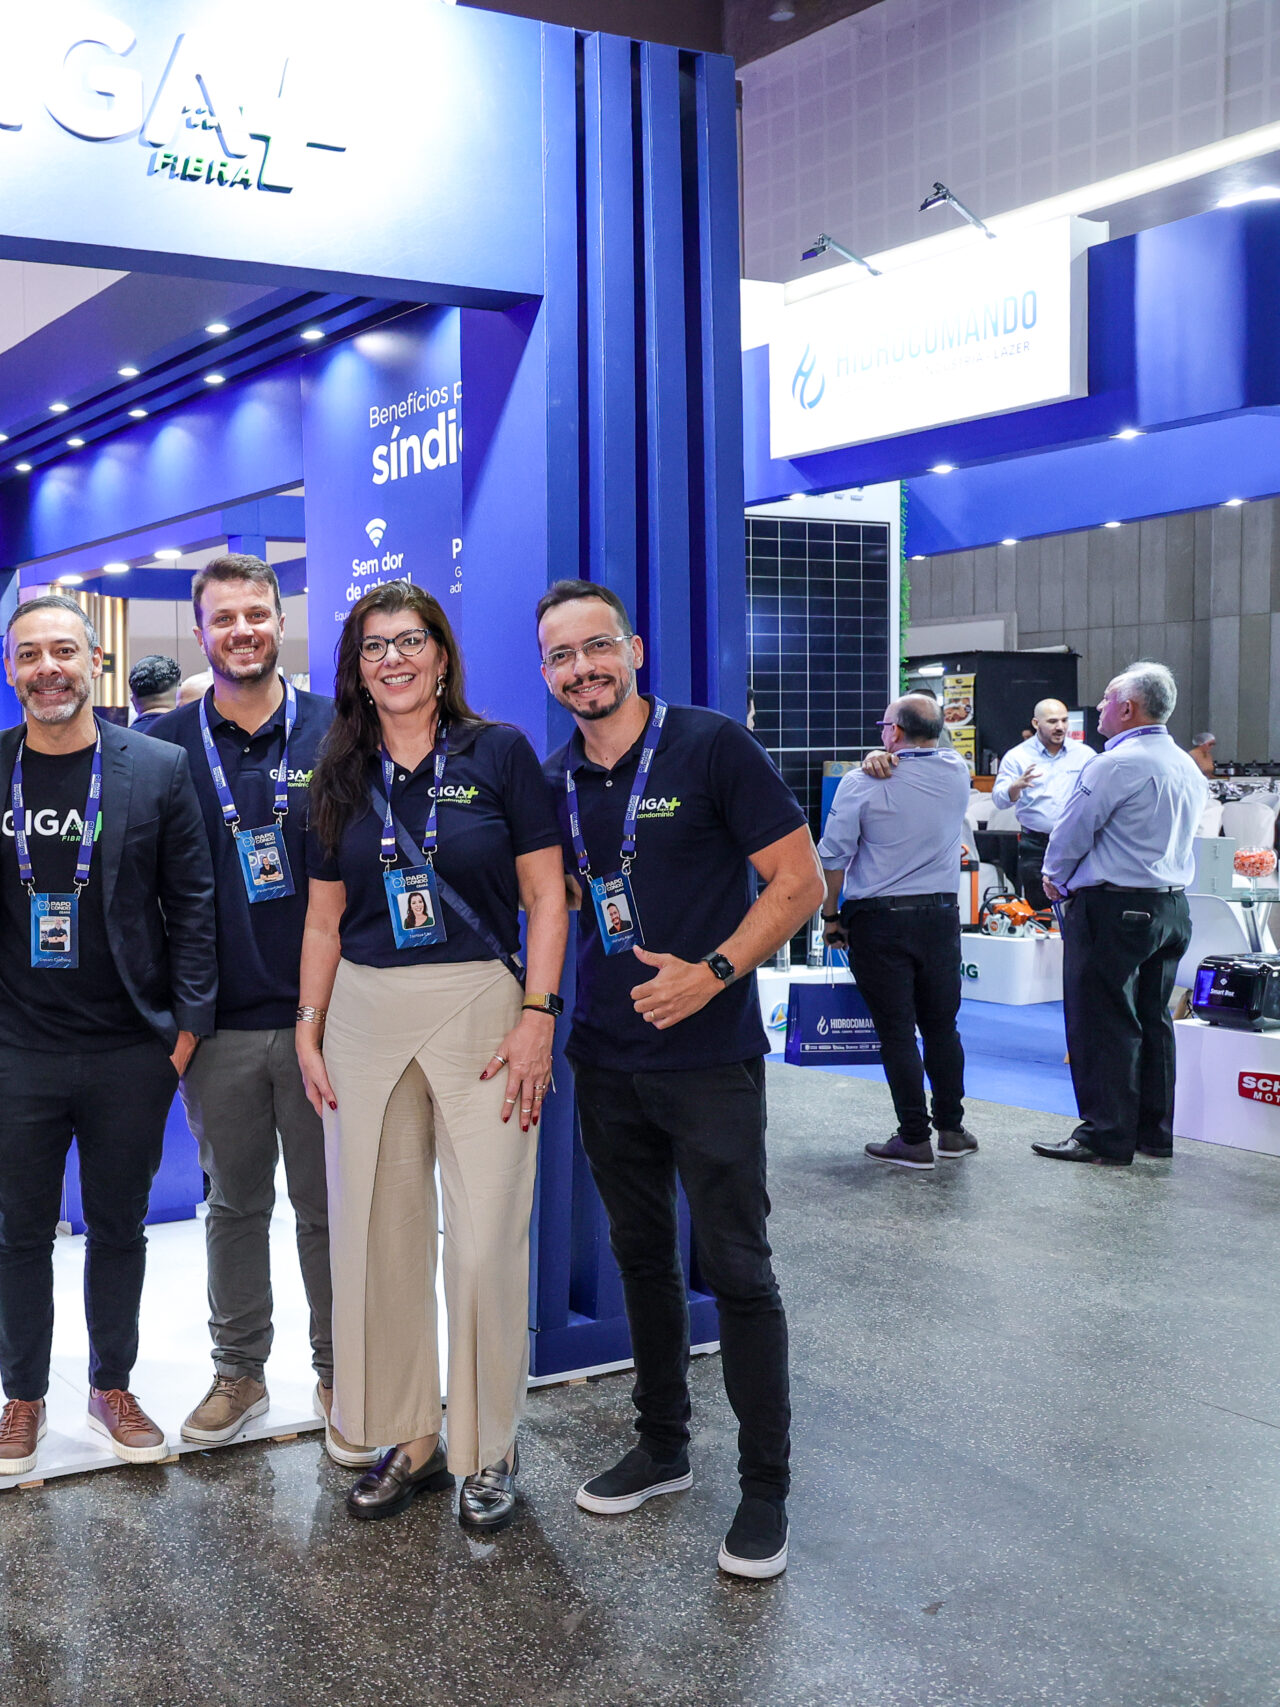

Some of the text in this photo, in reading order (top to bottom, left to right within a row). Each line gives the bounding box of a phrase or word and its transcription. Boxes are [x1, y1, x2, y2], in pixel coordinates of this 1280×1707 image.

[147, 150, 253, 190] FIBRA
[993, 340, 1031, 360] LAZER
[369, 386, 449, 429] Benefícios
[372, 407, 463, 485] síndi
[352, 551, 405, 578] Sem dor
[346, 582, 362, 602] de
[269, 768, 314, 782] GGA+
